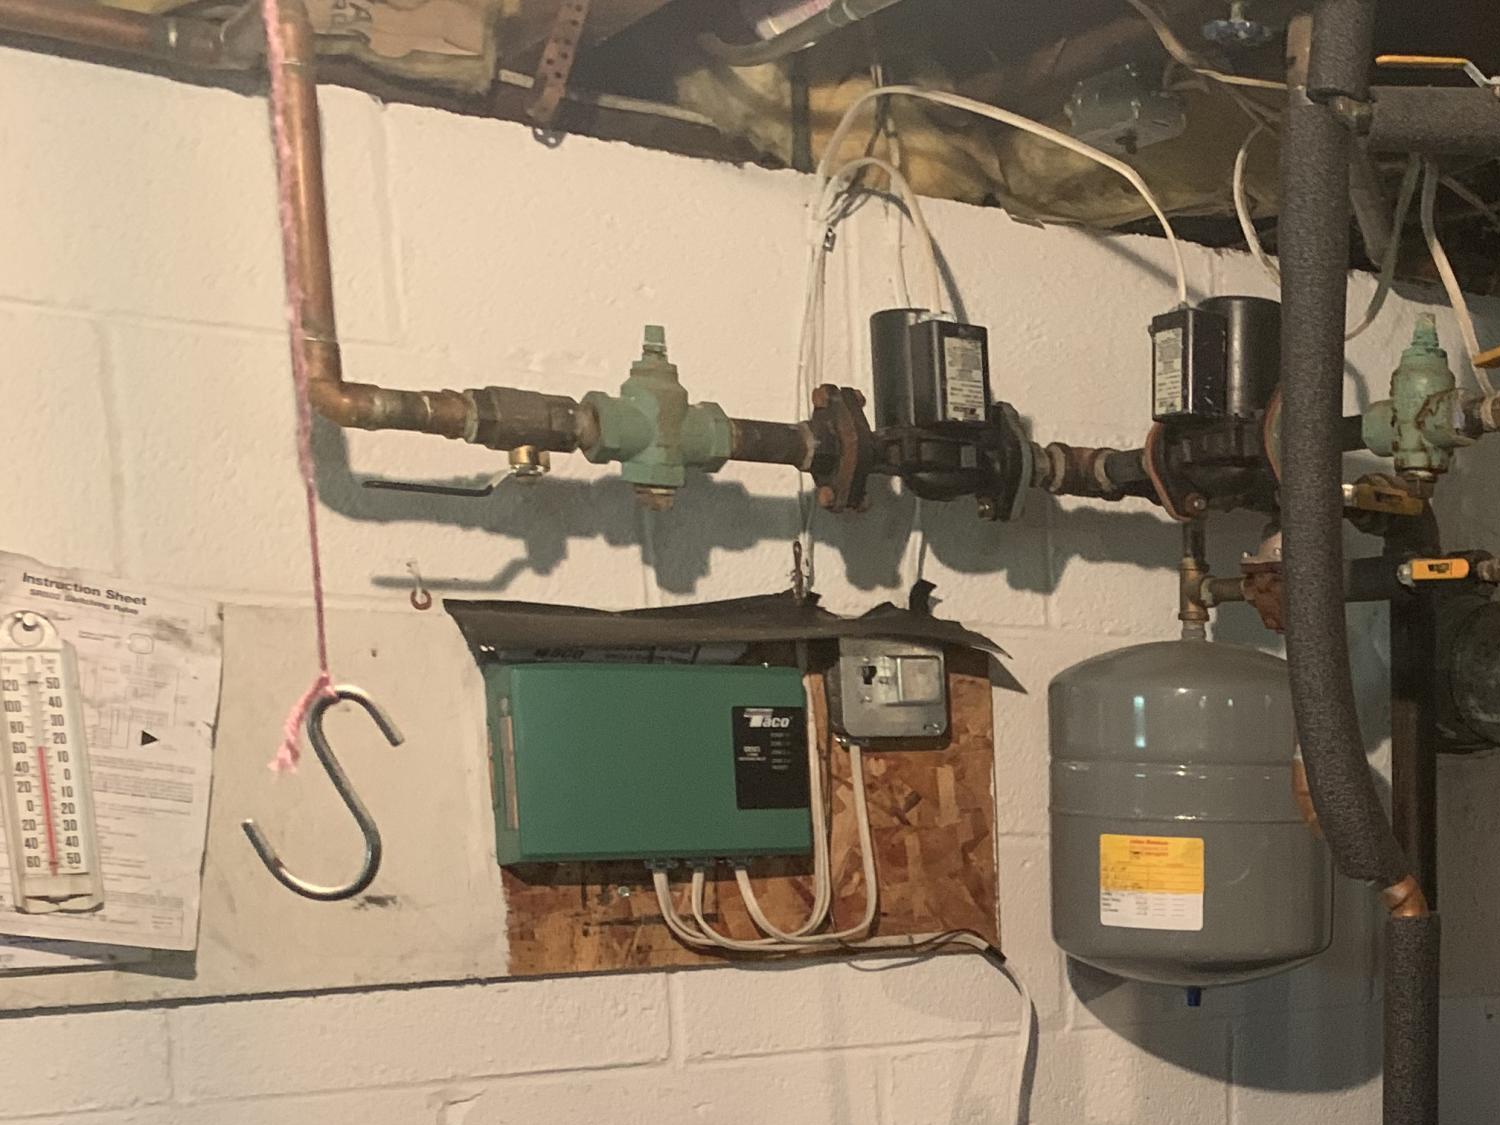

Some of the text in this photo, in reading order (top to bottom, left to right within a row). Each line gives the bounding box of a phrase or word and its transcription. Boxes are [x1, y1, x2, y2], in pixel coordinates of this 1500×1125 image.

[22, 572, 101, 597] Instruction
[105, 589, 147, 606] Sheet
[45, 676, 60, 690] 50
[3, 700, 22, 713] 100
[48, 695, 63, 708] 40
[743, 708, 791, 728] Taco
[9, 720, 25, 734] 80
[52, 731, 67, 745] 20
[57, 750, 70, 763] 10
[15, 760, 30, 773] 40
[63, 768, 72, 781] 0
[16, 780, 32, 794] 20
[61, 785, 74, 798] 10
[26, 799, 34, 812] 0
[60, 802, 76, 815] 20
[21, 818, 37, 831] 20
[62, 818, 78, 832] 30
[24, 836, 39, 850] 40
[65, 835, 80, 848] 40
[26, 855, 41, 868] 60
[66, 852, 82, 865] 50
